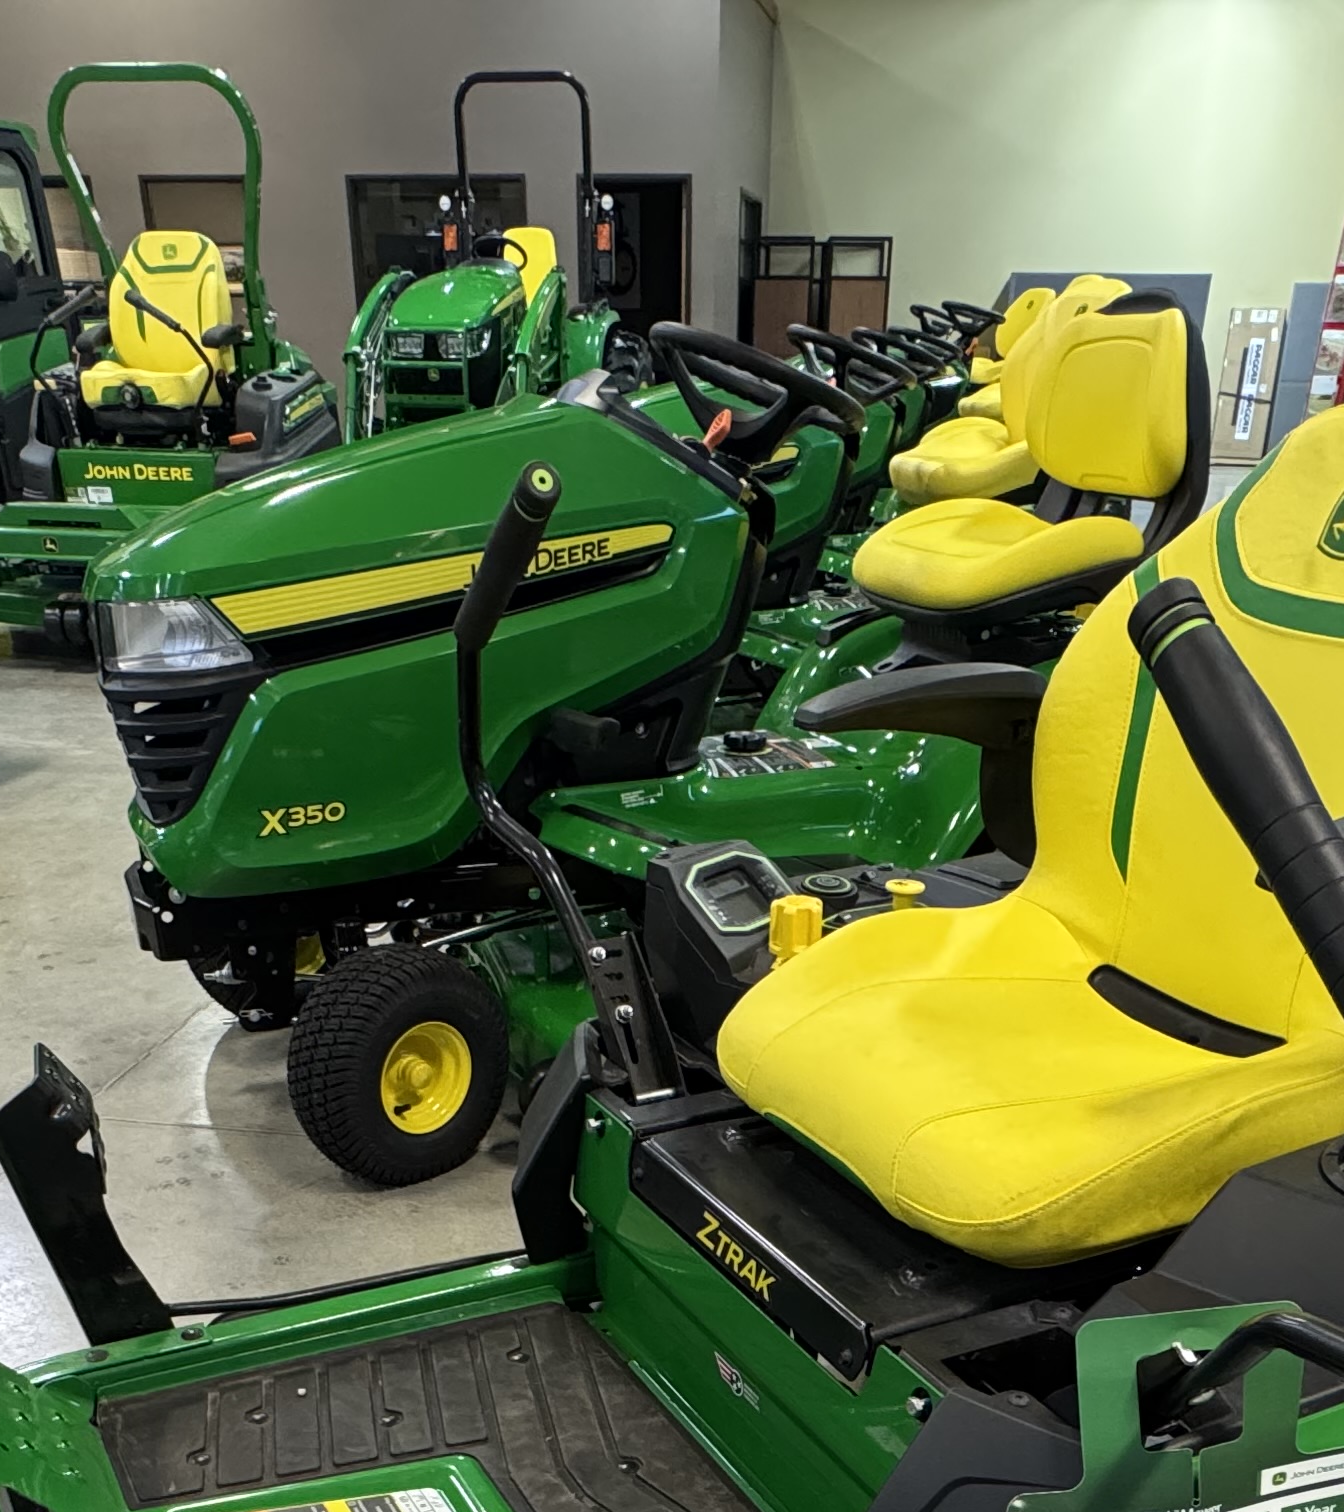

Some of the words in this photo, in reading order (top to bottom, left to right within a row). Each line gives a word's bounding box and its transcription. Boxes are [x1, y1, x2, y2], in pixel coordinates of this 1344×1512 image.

[84, 462, 131, 479] JOHN
[133, 463, 194, 481] DEERE
[535, 537, 610, 571] DEERE
[259, 802, 346, 837] X350
[696, 1211, 776, 1302] ZTRAK
[1290, 1468, 1315, 1480] JOHN
